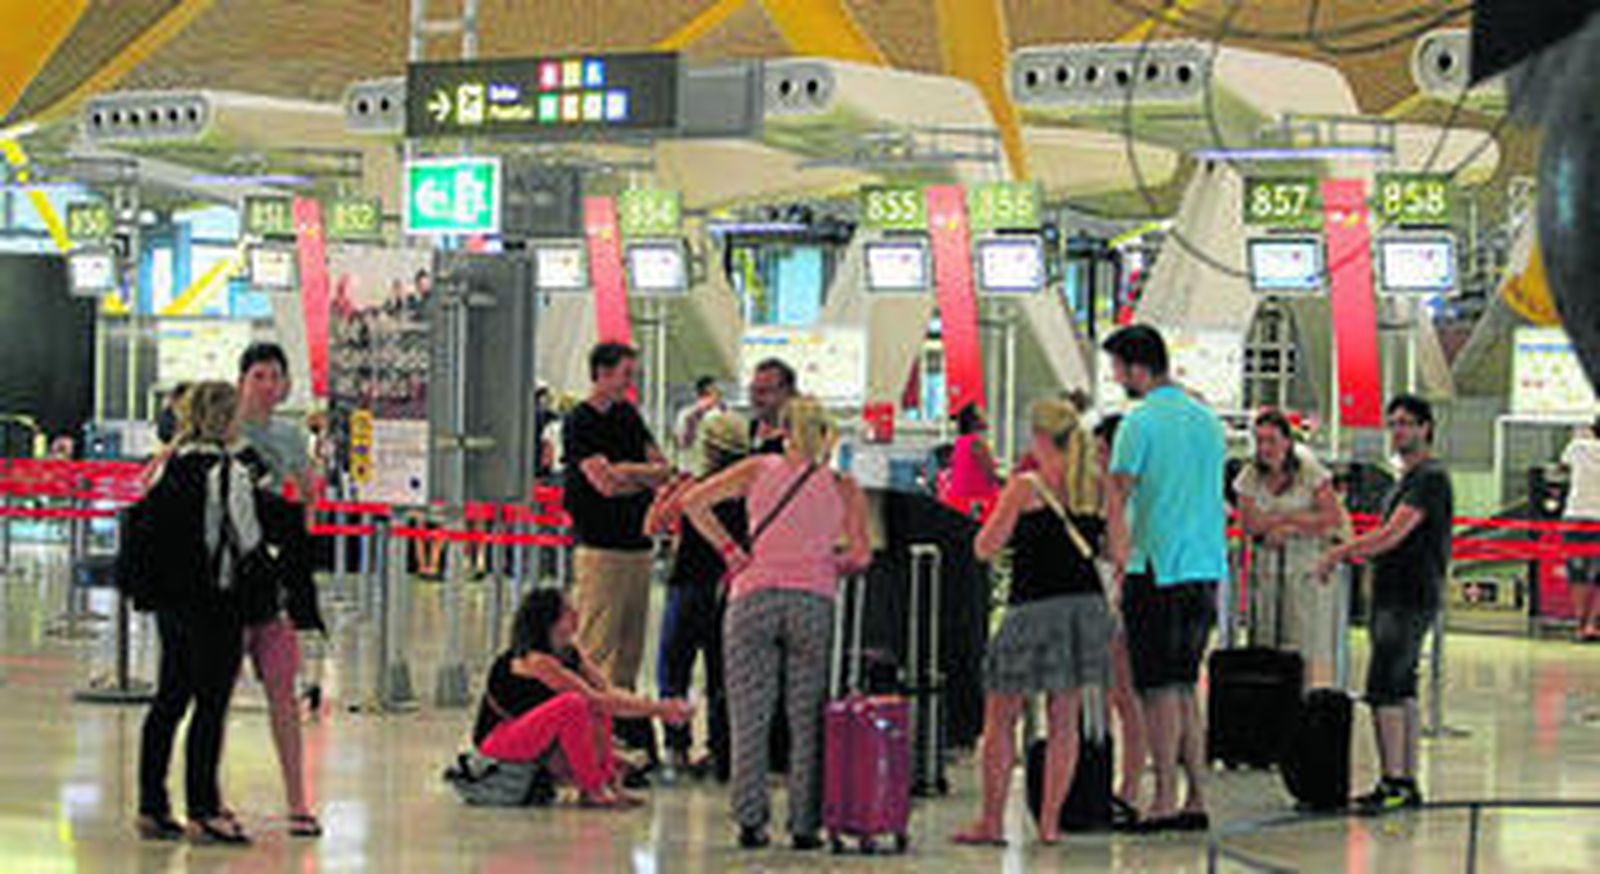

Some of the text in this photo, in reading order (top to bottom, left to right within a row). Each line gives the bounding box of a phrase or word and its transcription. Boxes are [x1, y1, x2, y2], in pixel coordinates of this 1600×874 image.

[866, 190, 918, 221] 855
[1253, 184, 1309, 217] 857
[1383, 182, 1446, 216] 858
